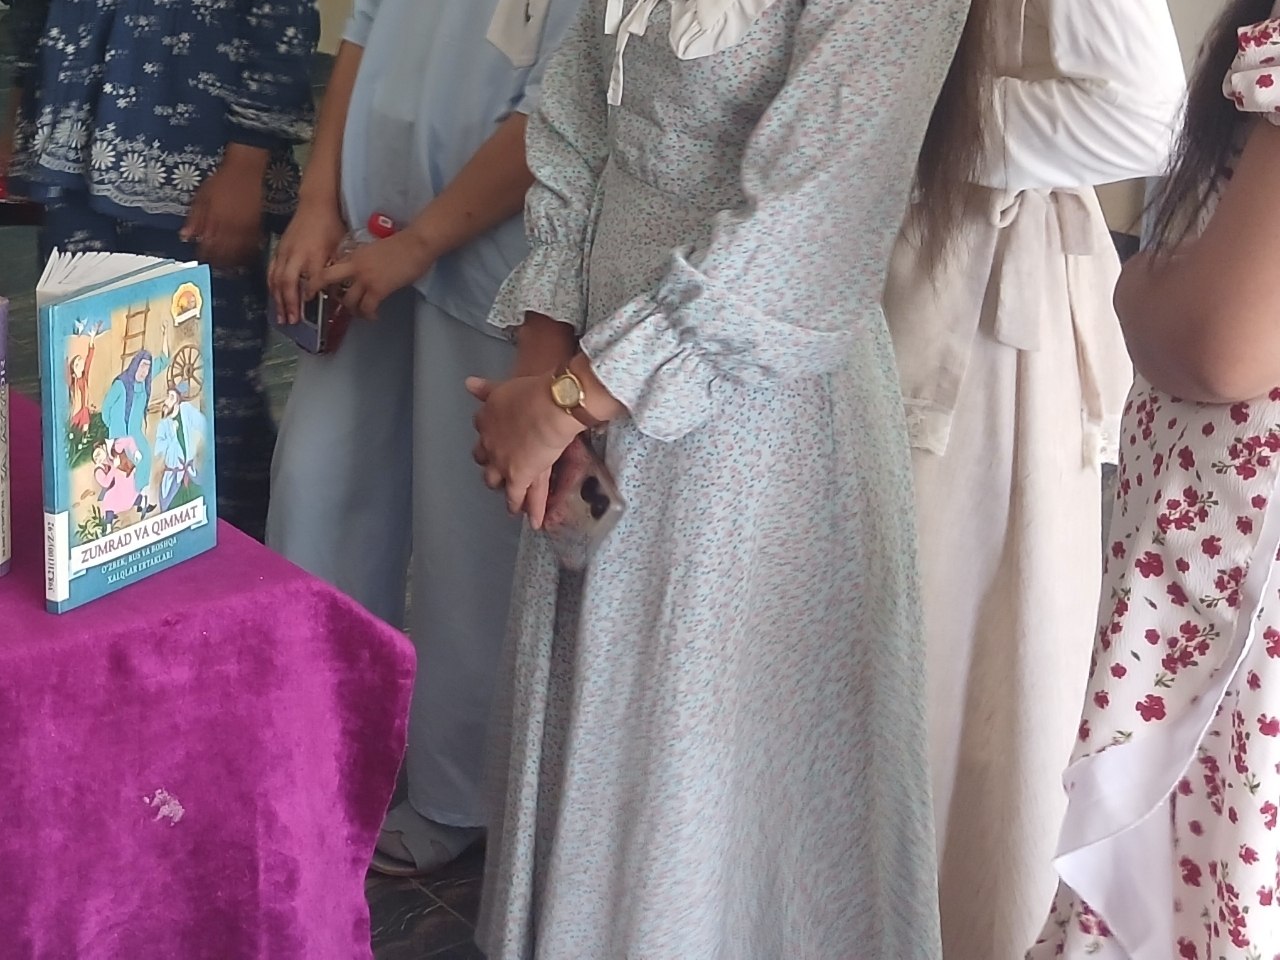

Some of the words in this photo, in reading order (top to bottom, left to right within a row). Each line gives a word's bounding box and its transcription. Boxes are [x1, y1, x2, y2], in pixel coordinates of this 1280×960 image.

[81, 533, 132, 564] ZUMRAD
[134, 526, 149, 541] VA
[151, 505, 198, 537] QIMMAT
[128, 550, 141, 563] RUS
[141, 547, 151, 558] VA
[151, 536, 178, 554] BOSHQA
[107, 565, 138, 585] XALQLAR
[138, 549, 174, 572] ERTAKLARI
